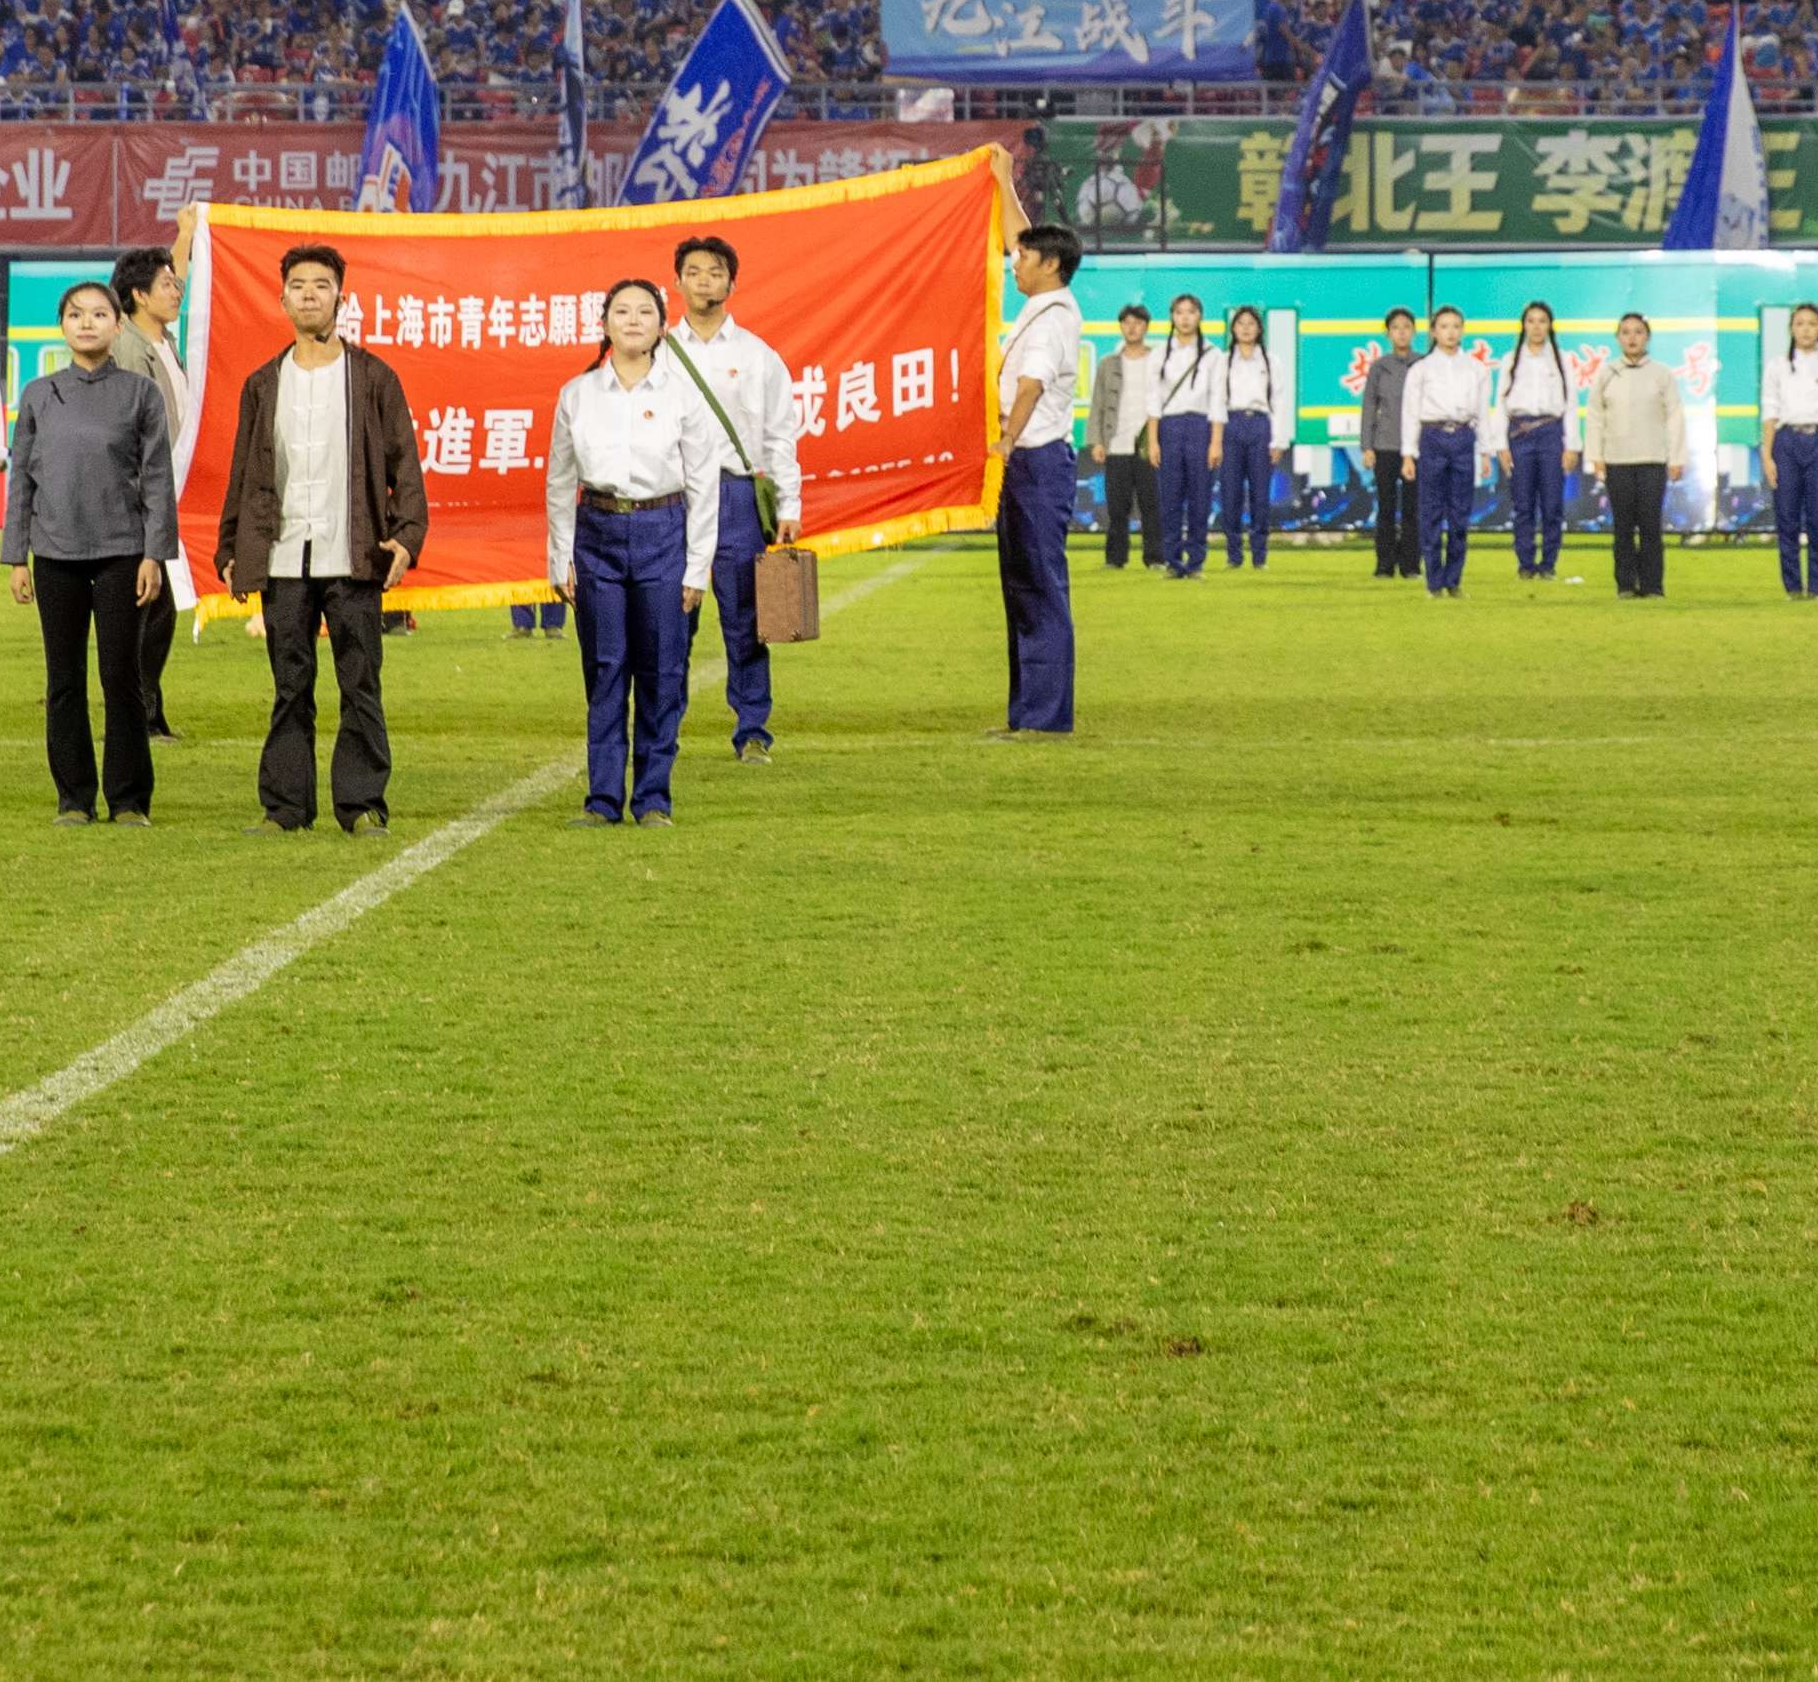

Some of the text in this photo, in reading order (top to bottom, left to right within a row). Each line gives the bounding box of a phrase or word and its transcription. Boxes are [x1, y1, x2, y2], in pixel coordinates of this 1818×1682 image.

[233, 150, 361, 191] 中国邮
[335, 291, 609, 350] 給上海市青年志願墾
